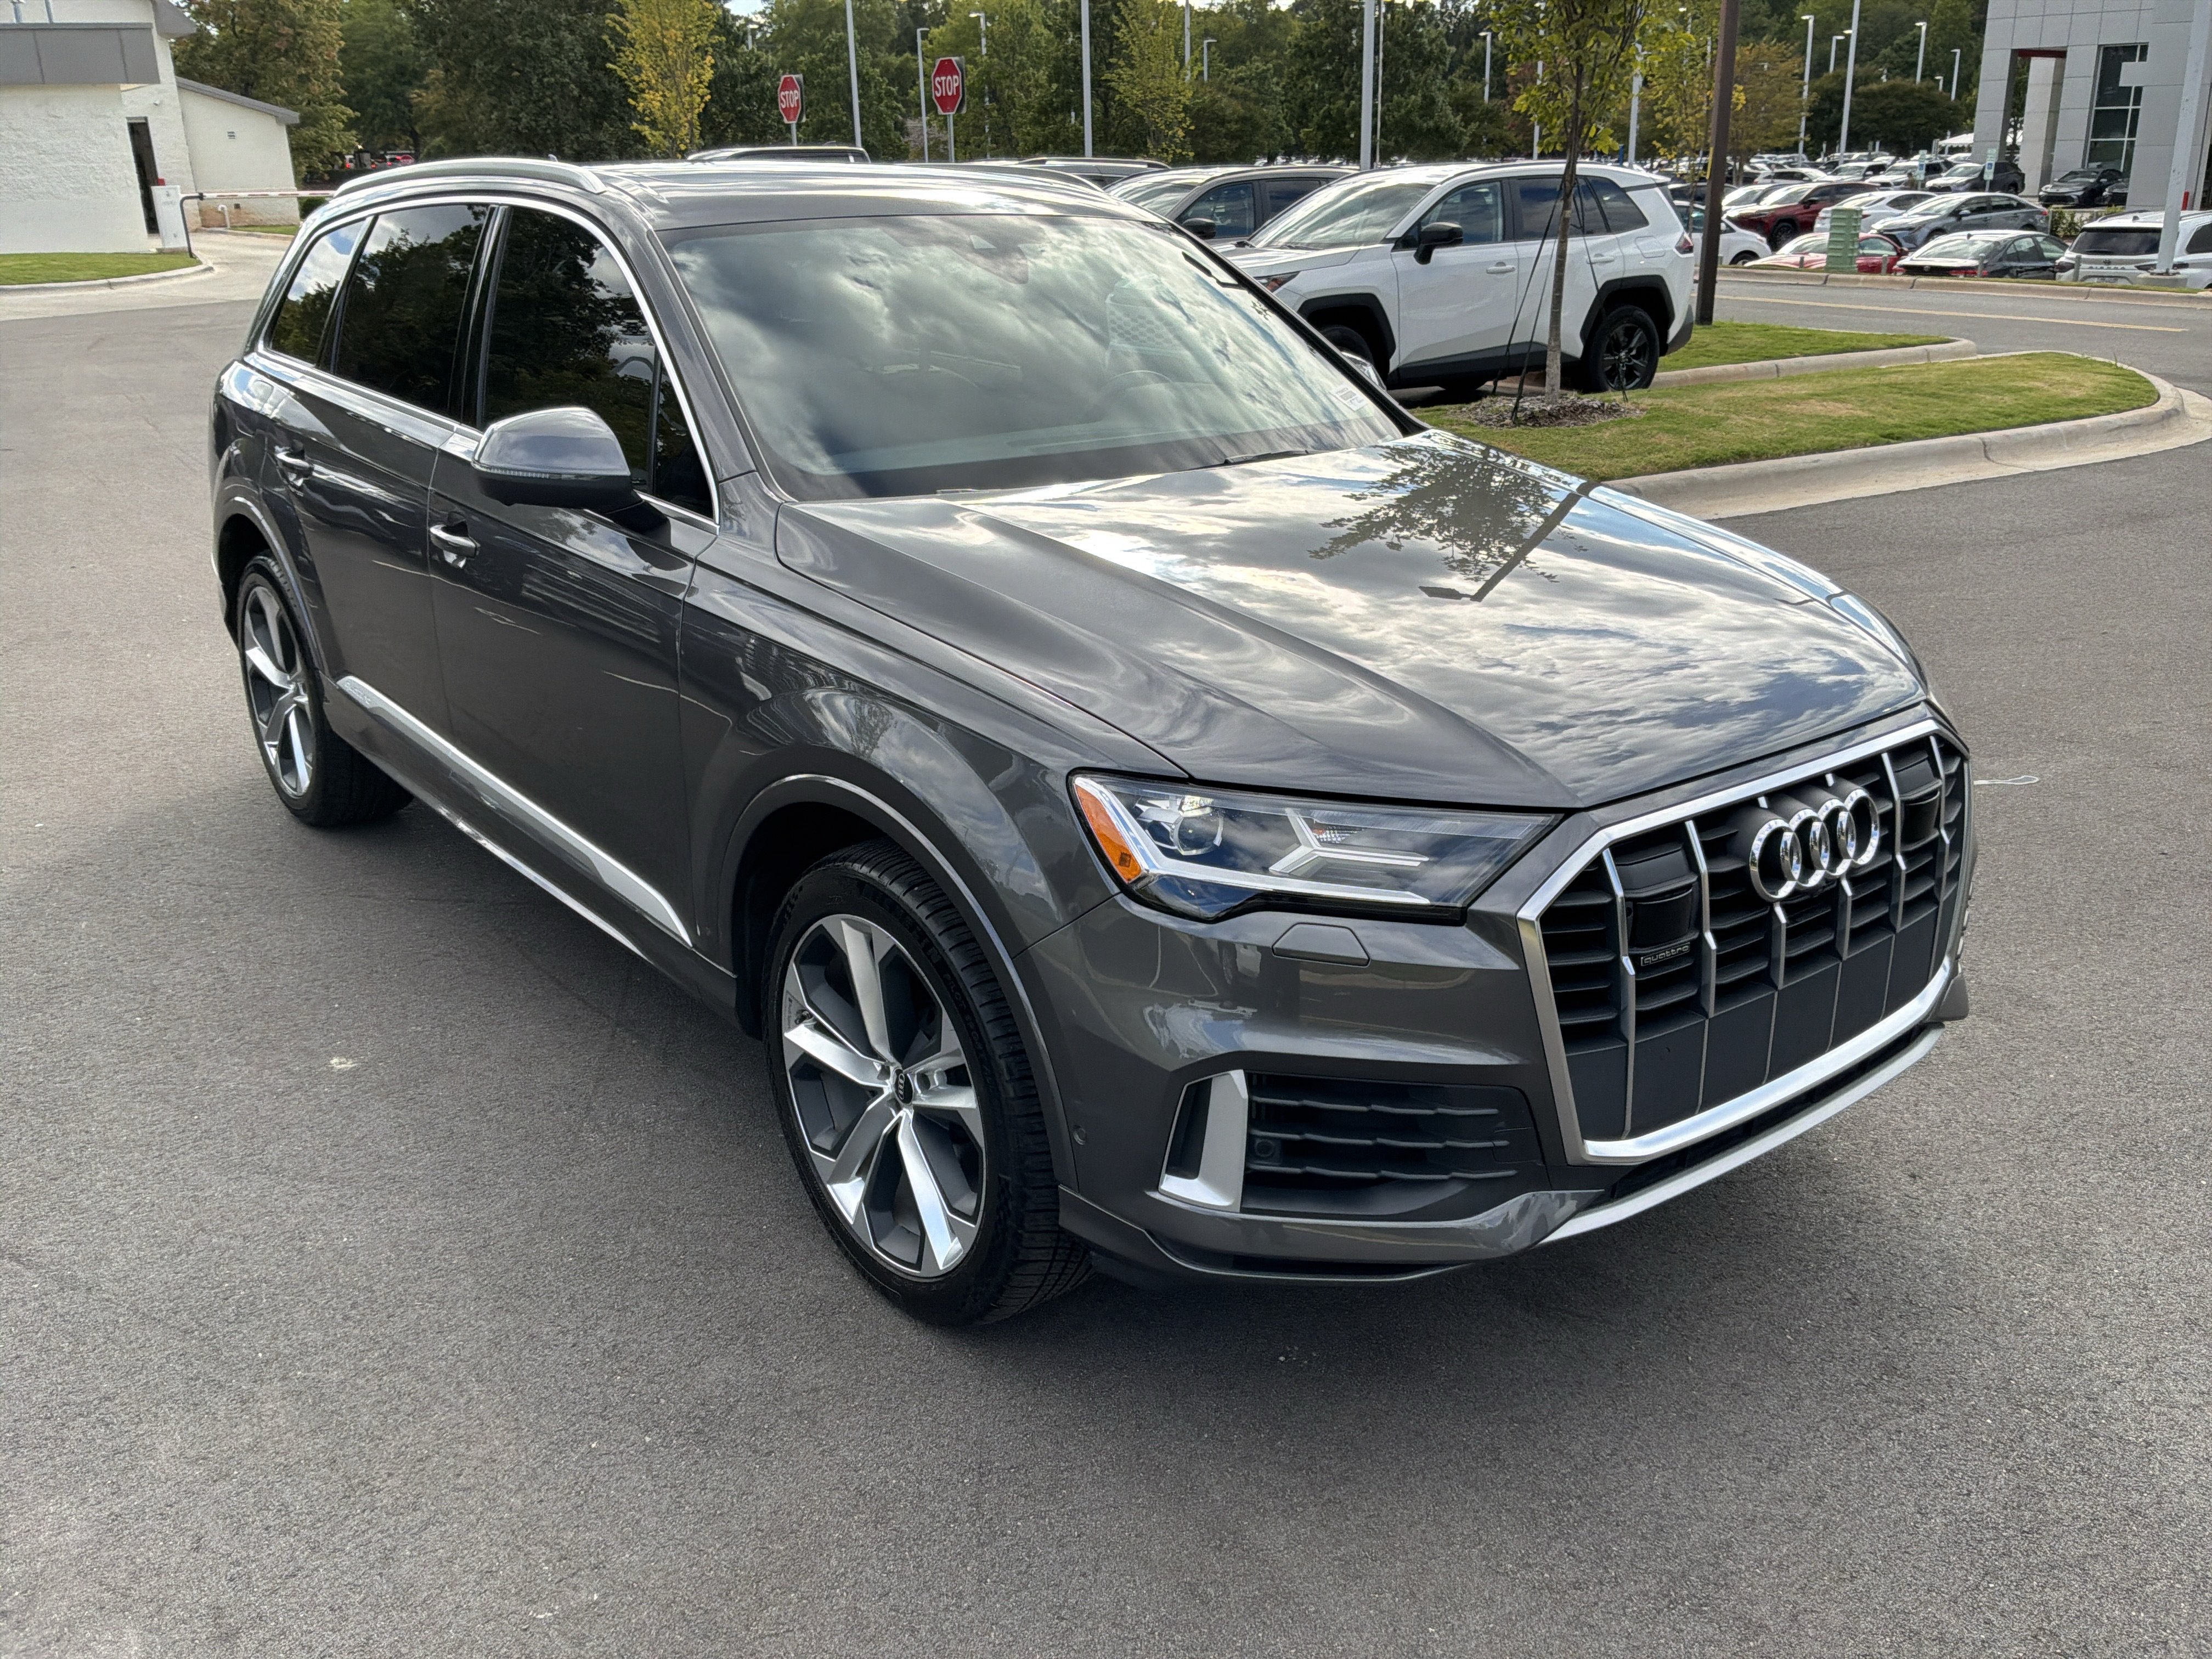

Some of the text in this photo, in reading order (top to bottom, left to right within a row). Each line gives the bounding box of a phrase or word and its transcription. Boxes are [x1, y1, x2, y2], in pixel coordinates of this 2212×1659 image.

[935, 76, 959, 97] STOP
[780, 90, 799, 109] STOP
[1644, 945, 1689, 964] quattro
